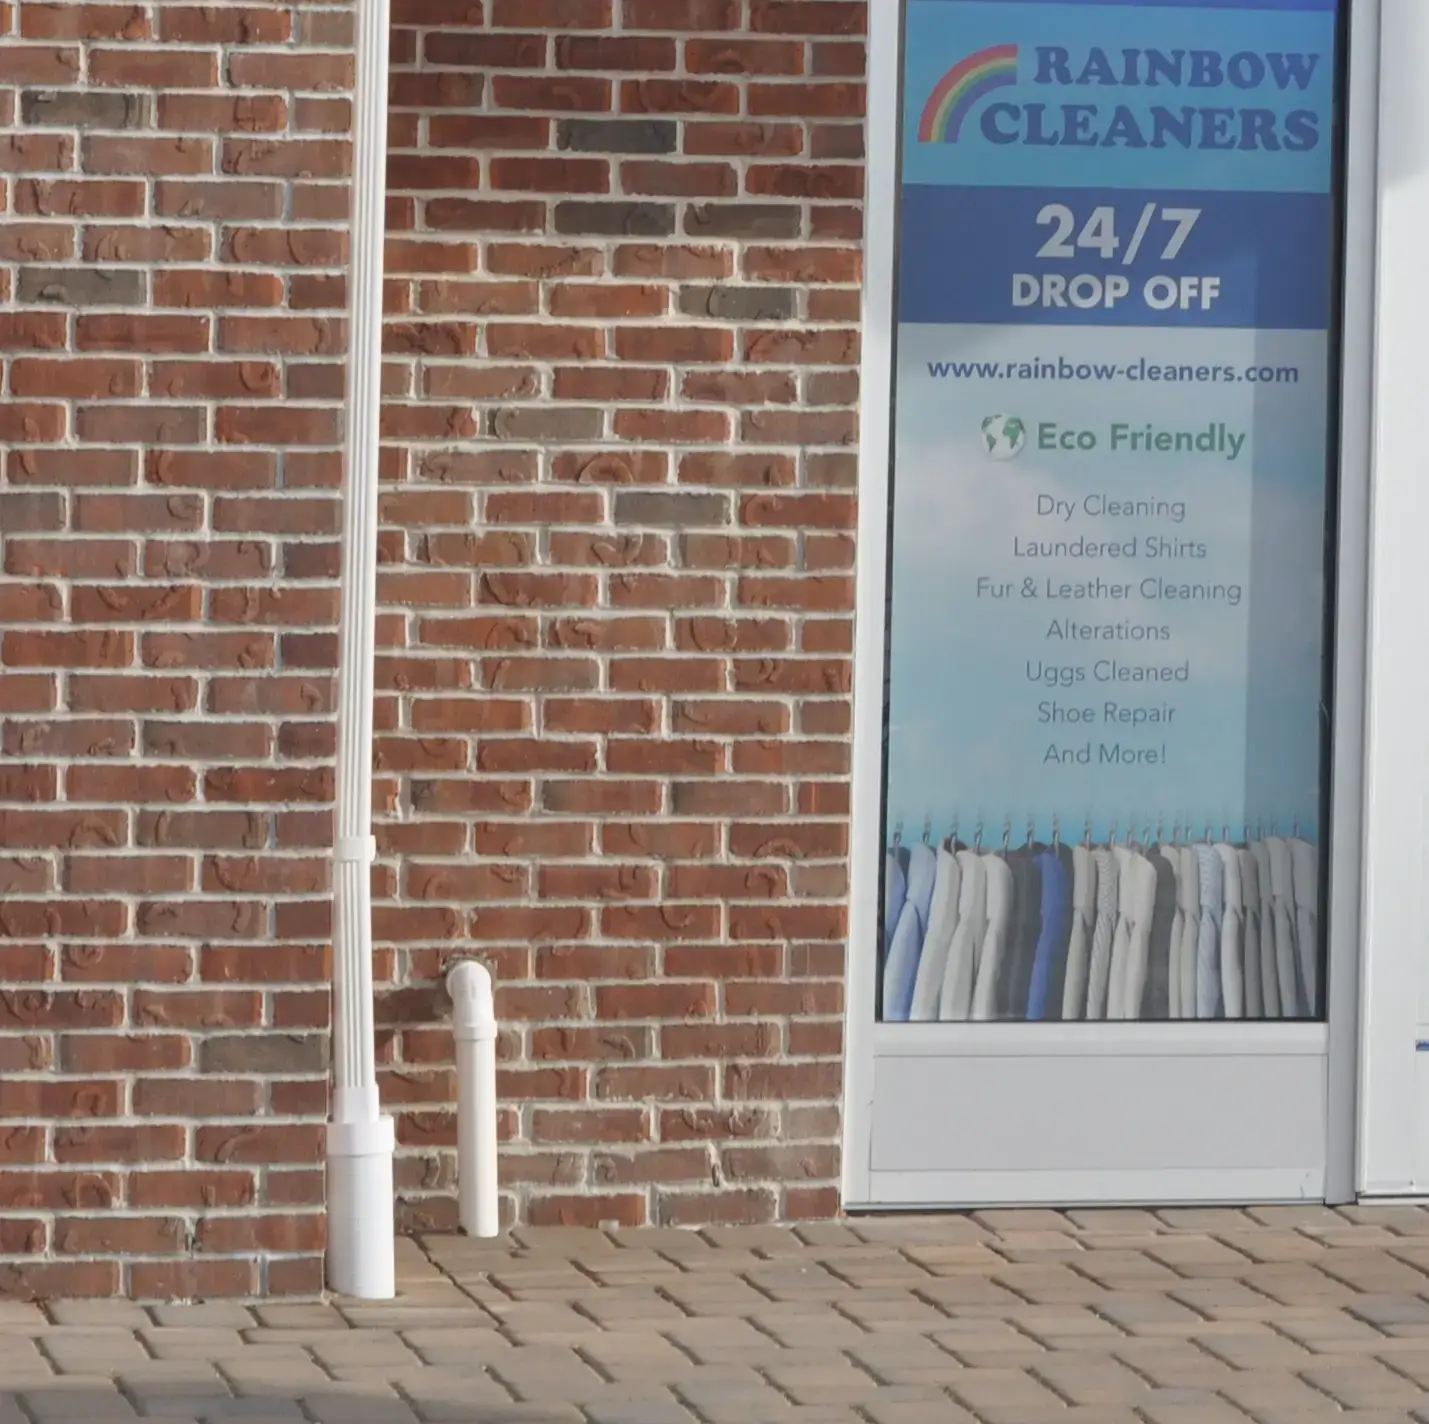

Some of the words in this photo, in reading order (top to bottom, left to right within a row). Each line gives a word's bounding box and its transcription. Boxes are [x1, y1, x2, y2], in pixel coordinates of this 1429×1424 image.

[1033, 45, 1321, 91] RAINBOW
[979, 102, 1320, 152] CLEANERS
[1034, 202, 1203, 265] 24/7
[1012, 273, 1131, 309] DROP
[1143, 275, 1221, 311] OFF
[926, 356, 1299, 384] www.rainbow-cleaners.com
[1037, 422, 1097, 451] Eco
[1110, 422, 1246, 460] Friendly
[1036, 494, 1076, 522] Dry
[1083, 494, 1187, 523] Cleaning
[1013, 536, 1138, 559] Laundered
[1144, 537, 1208, 559] Shirts
[976, 577, 1014, 599] Fur
[1020, 577, 1039, 599] &
[1046, 577, 1132, 600] Leather
[1139, 578, 1243, 605] Cleaning
[1045, 619, 1171, 642] Alterations
[1025, 661, 1086, 687] Uggs
[1093, 660, 1190, 683] Cleaned
[1037, 701, 1096, 724] Shoe
[1103, 702, 1176, 728] Repair
[1043, 742, 1091, 764] And
[1099, 743, 1167, 765] More!
